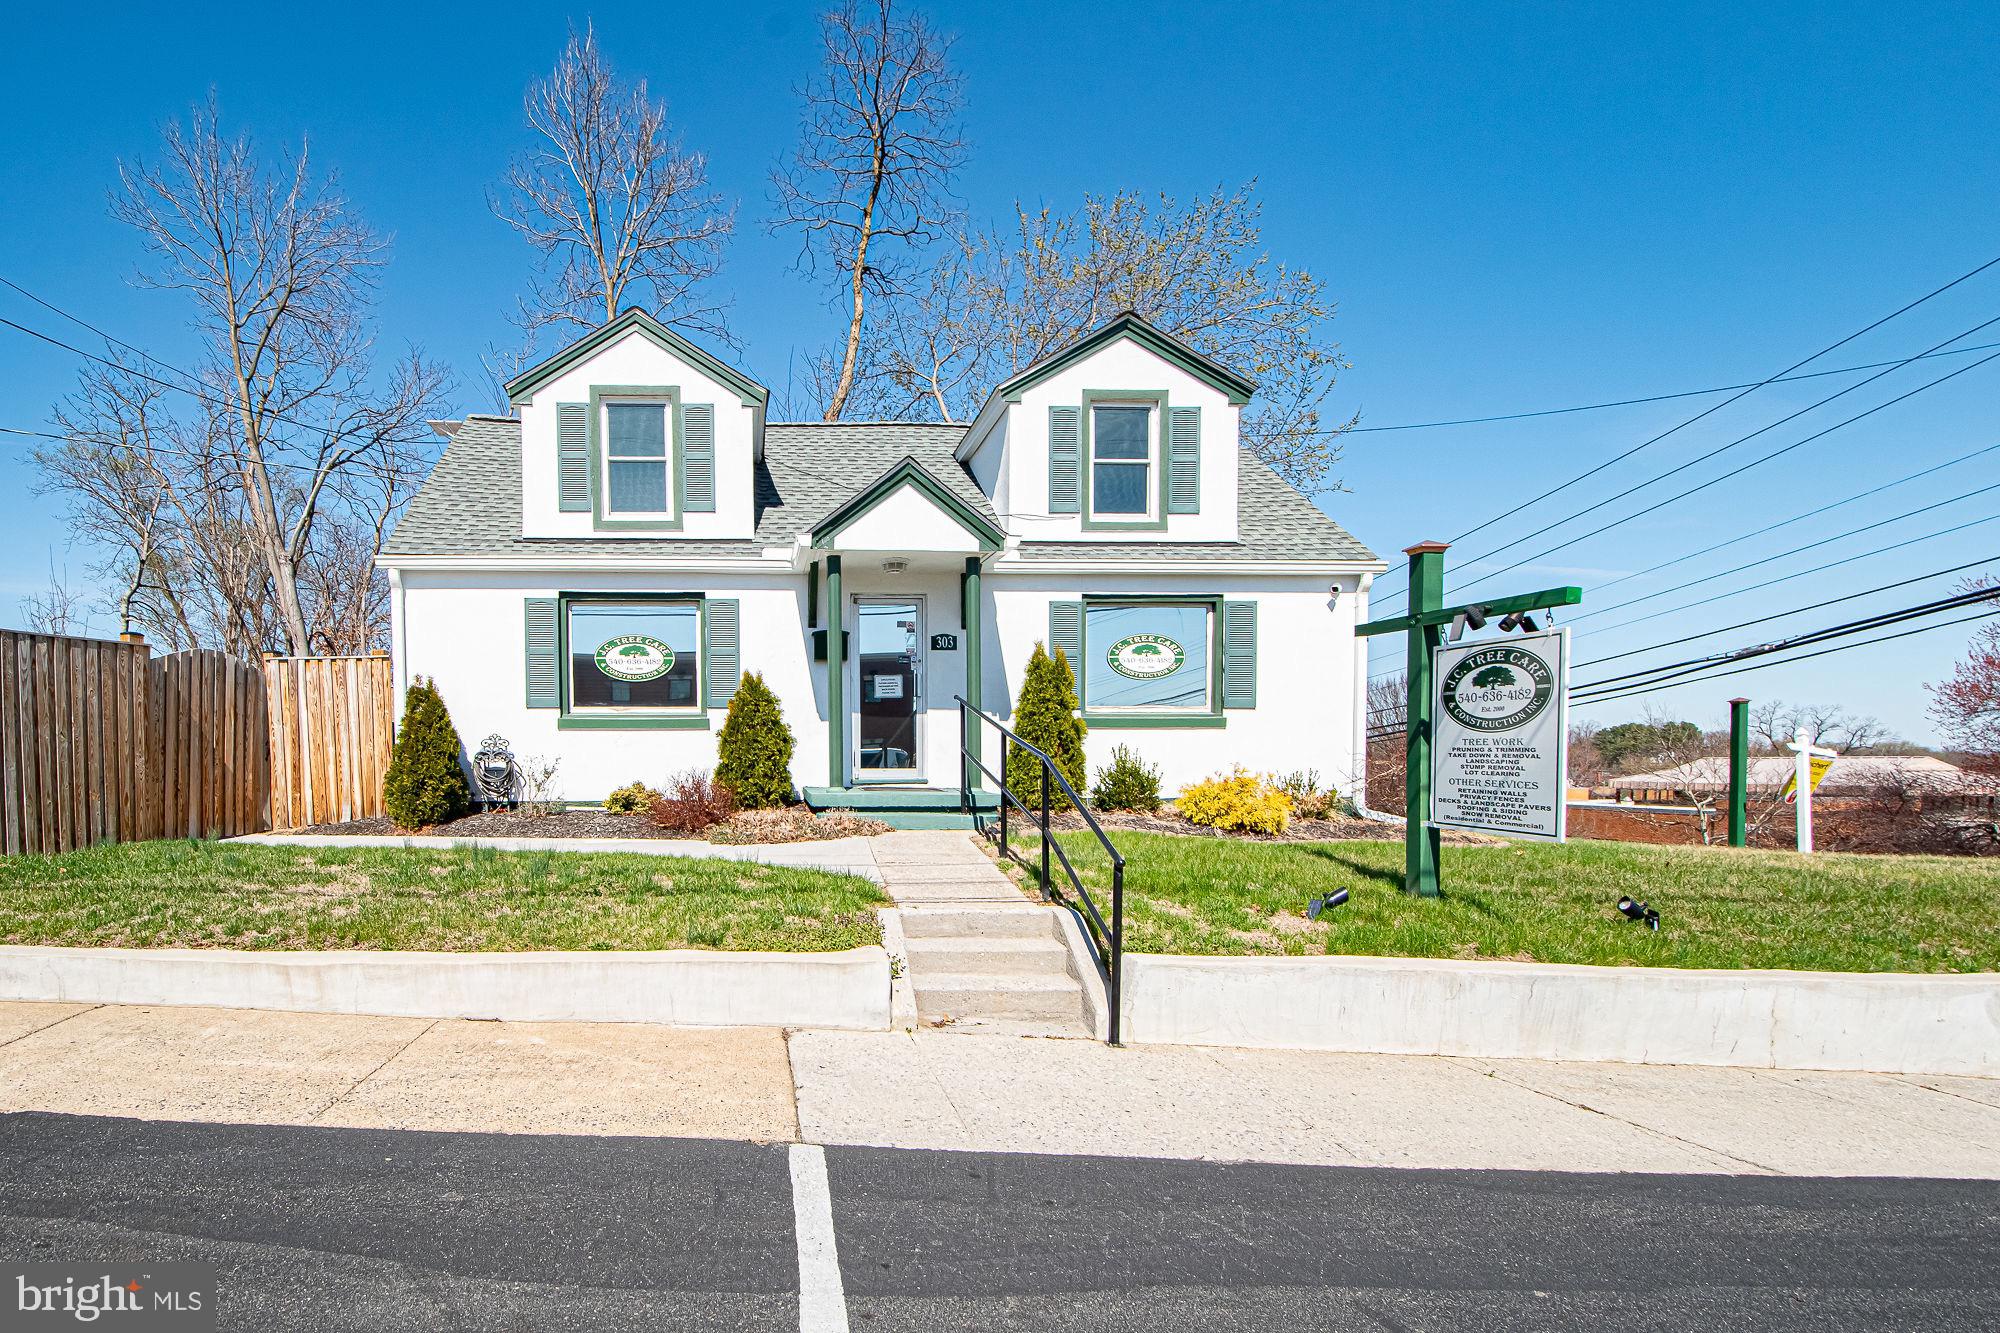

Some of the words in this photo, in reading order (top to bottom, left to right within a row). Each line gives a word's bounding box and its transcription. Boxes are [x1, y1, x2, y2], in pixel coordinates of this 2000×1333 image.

[614, 636, 643, 645] TREE
[645, 638, 671, 656] CARE
[935, 636, 954, 649] 303
[1127, 635, 1155, 644] TREE
[1157, 637, 1183, 654] CARE
[606, 668, 659, 680] CONSTRUCTION
[1118, 665, 1169, 678] CONSTRUCTION
[1447, 669, 1467, 688] J.C.
[1466, 650, 1506, 668] TREE
[1509, 652, 1547, 681] CARE
[1458, 688, 1532, 704] 540-636-4182
[1448, 702, 1454, 710] &
[1454, 710, 1527, 728] CONSTRUCTION
[1526, 697, 1544, 714] INC.
[1462, 738, 1489, 746] TREE
[1492, 737, 1524, 746] WORK
[1448, 777, 1482, 787] OTHER
[1484, 779, 1539, 790] SERVICES
[1459, 793, 1492, 801] PRIVACY
[1470, 800, 1516, 808] LANDSCAPE
[1518, 803, 1552, 811] PAVERS
[1500, 808, 1528, 816] SIDING
[1443, 815, 1485, 824] (Residential
[1494, 819, 1544, 830] Commercial)
[1485, 812, 1523, 821] REMOVAL
